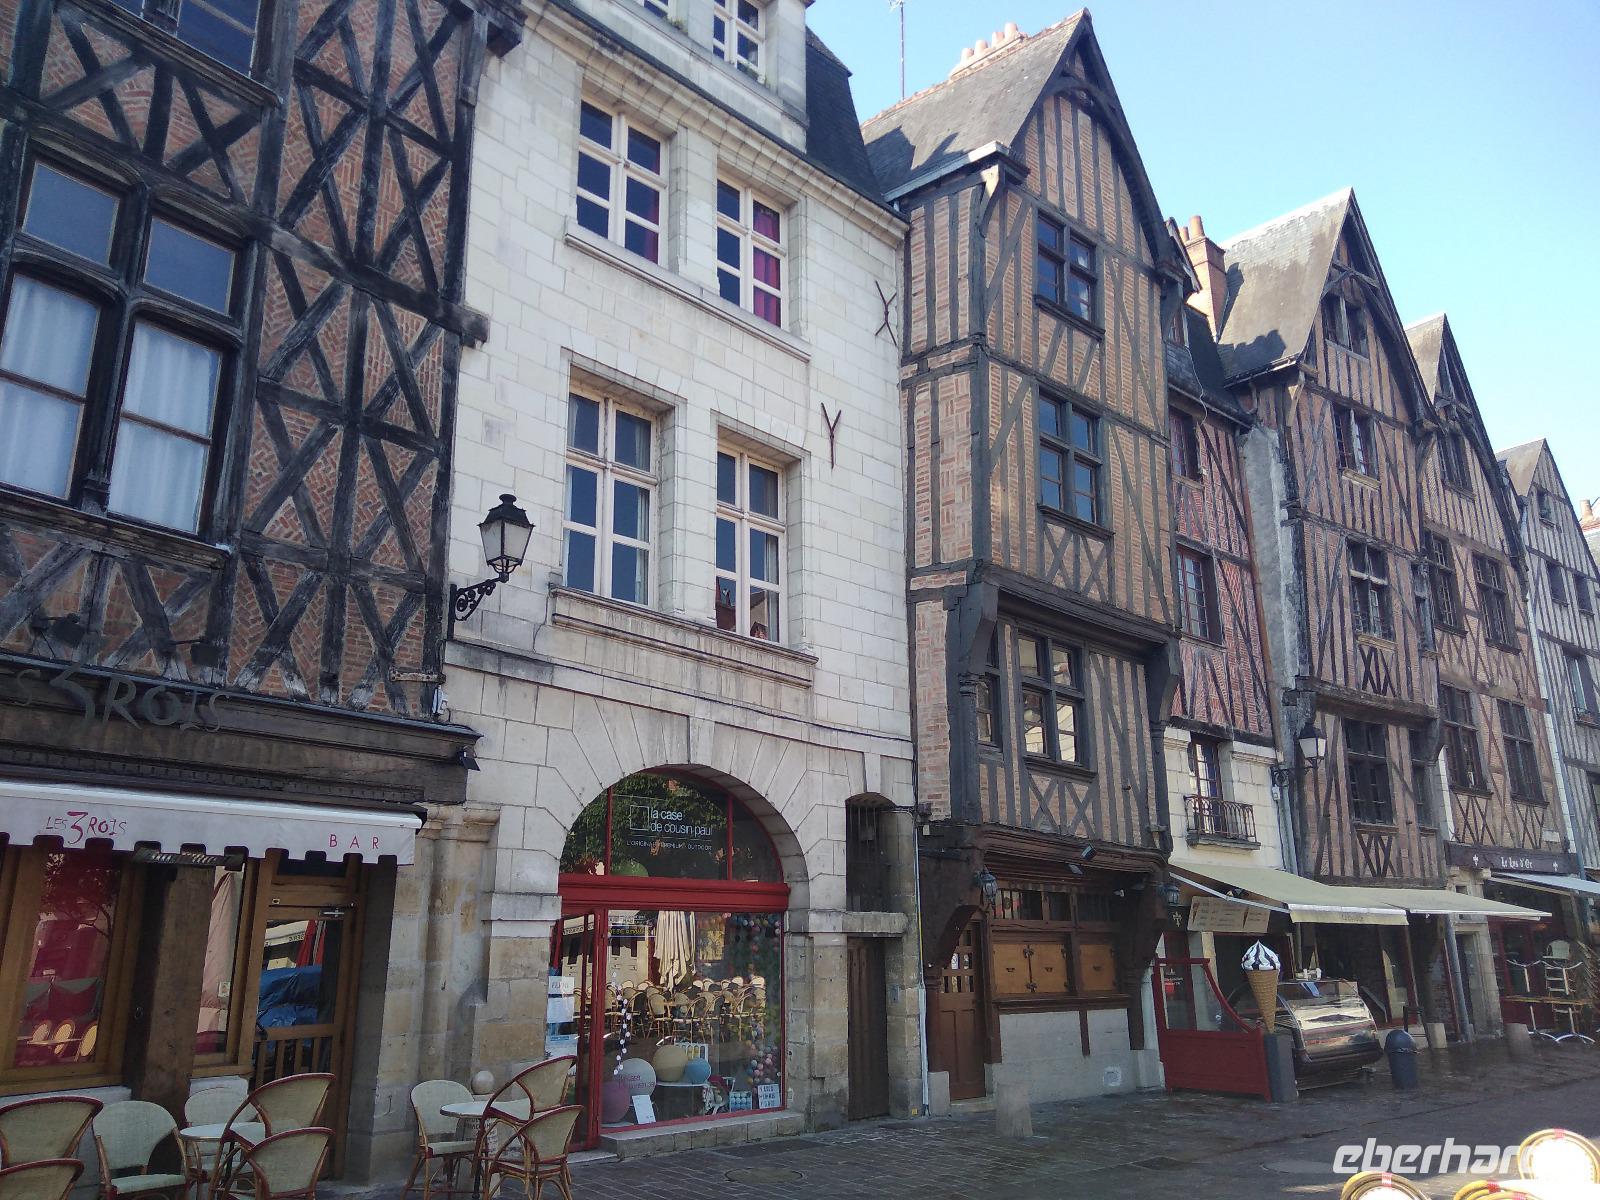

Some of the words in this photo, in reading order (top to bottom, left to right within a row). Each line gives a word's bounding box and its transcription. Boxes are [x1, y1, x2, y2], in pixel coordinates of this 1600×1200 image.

[102, 675, 230, 733] ROIS
[650, 806, 659, 819] la
[660, 810, 683, 821] case
[45, 815, 68, 830] LES
[66, 811, 89, 845] 3
[86, 816, 127, 836] ROIS
[650, 821, 662, 832] de
[663, 823, 693, 834] cousin
[694, 825, 712, 838] paul
[329, 833, 379, 850] BAR
